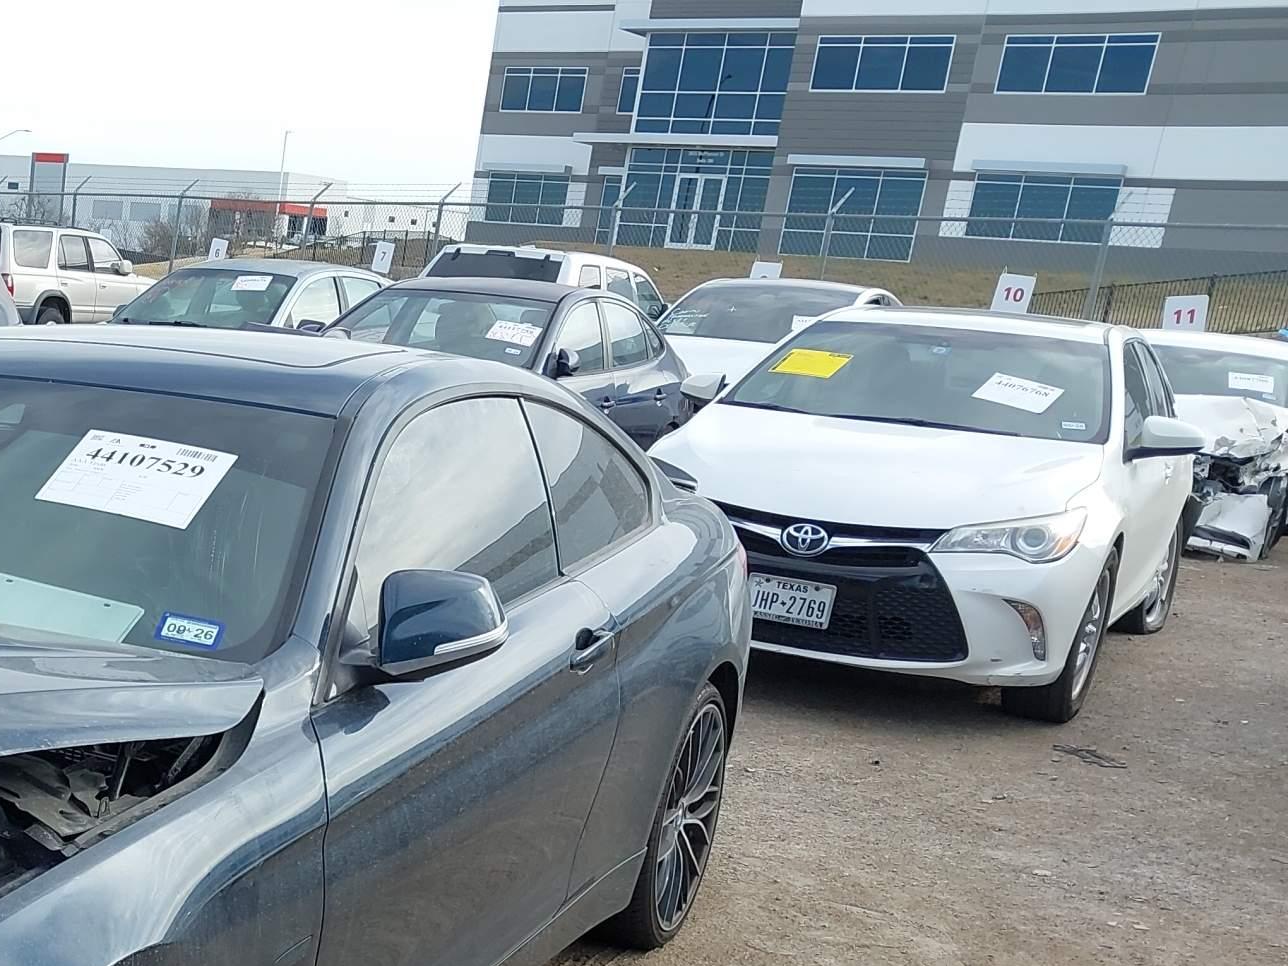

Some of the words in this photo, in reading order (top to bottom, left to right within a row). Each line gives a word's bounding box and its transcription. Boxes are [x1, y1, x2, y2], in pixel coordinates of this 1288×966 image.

[380, 251, 387, 261] 7
[1003, 286, 1025, 302] 10
[1173, 308, 1197, 324] 11
[86, 447, 206, 478] 44107529
[776, 581, 809, 594] TEXAS
